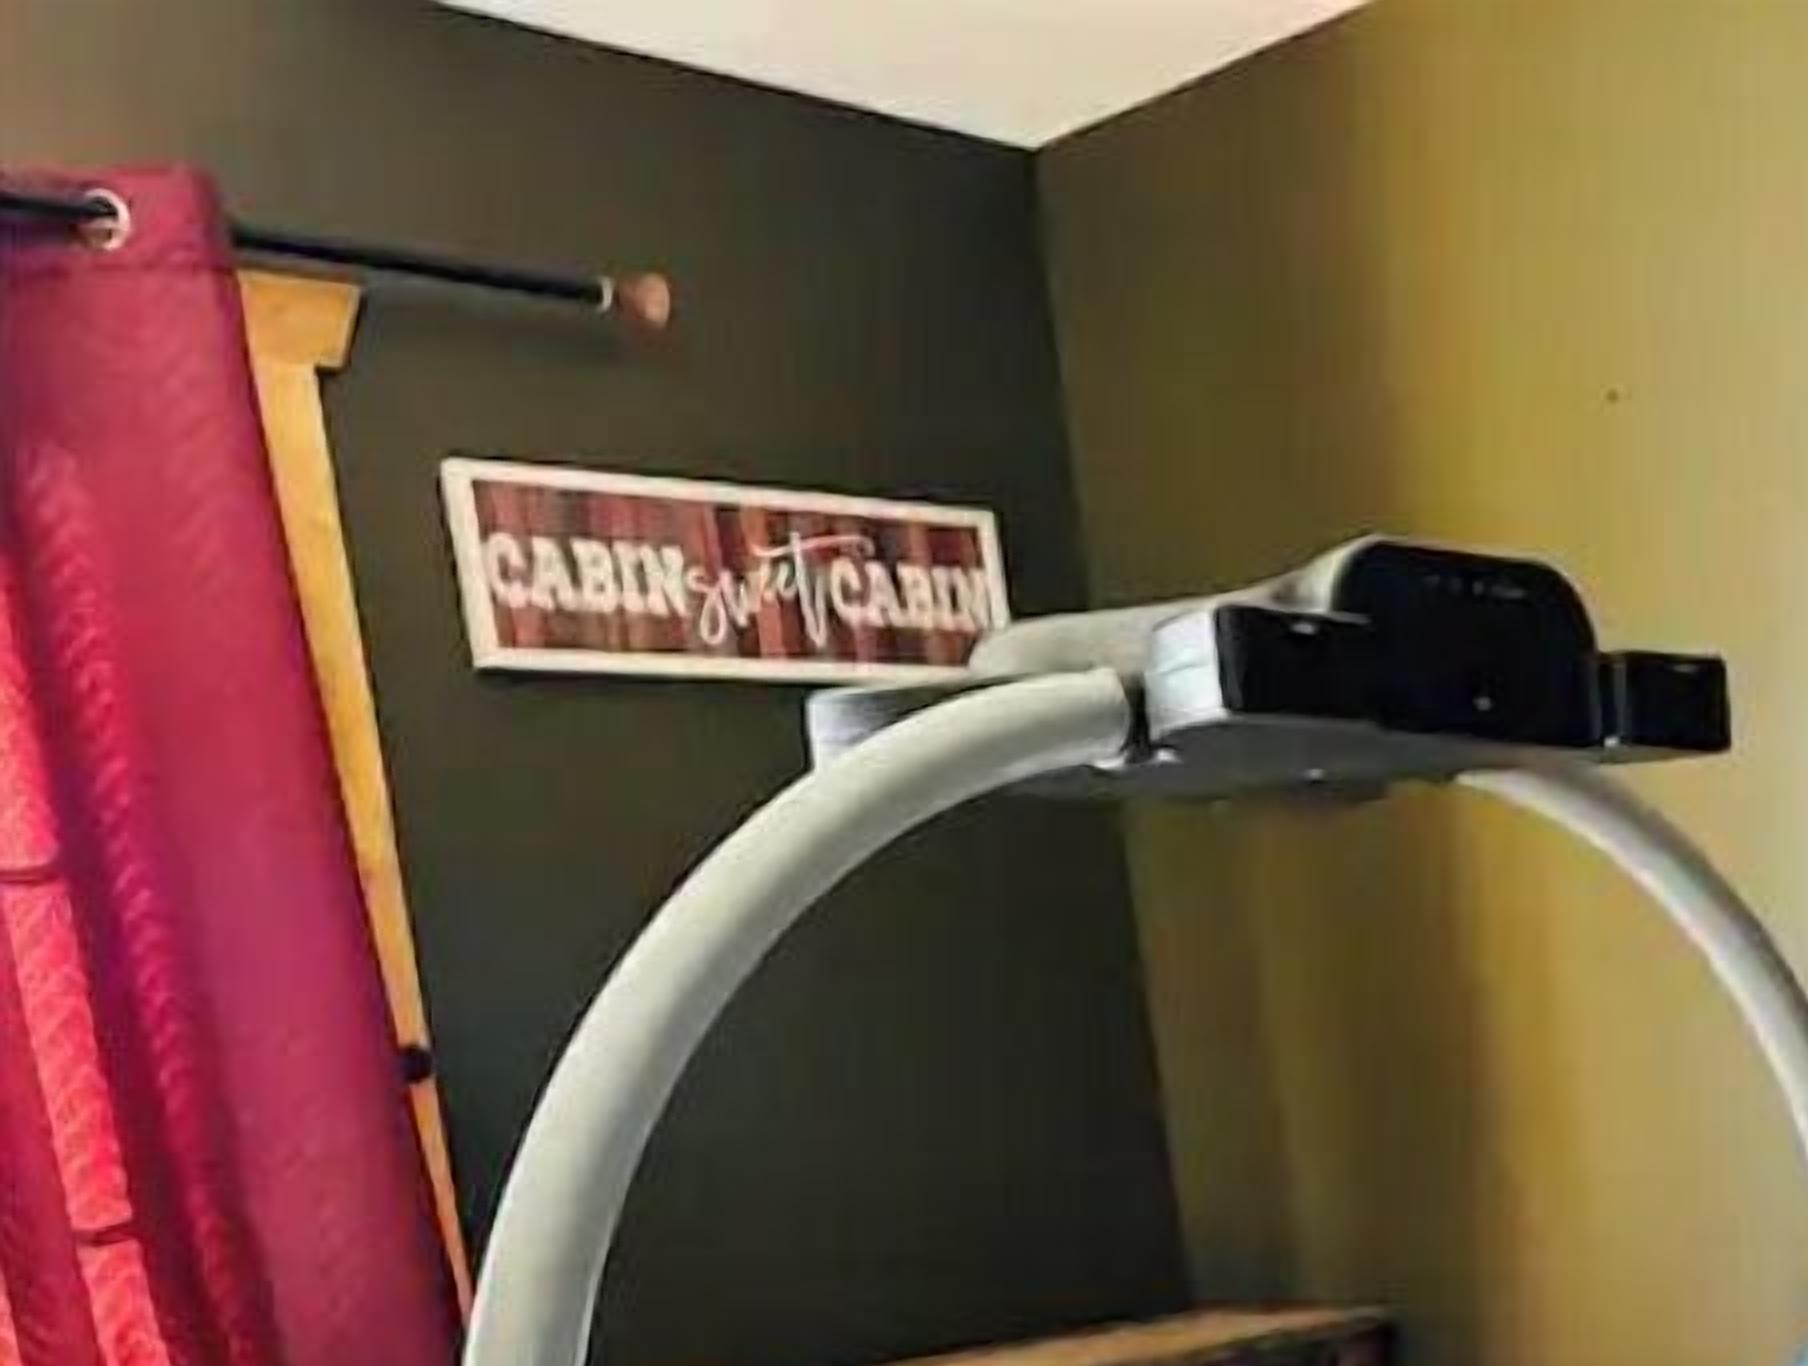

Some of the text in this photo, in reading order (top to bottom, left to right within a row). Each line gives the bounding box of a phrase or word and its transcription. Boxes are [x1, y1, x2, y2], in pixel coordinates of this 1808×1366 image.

[483, 531, 994, 647] CABIN sweet CABIN
